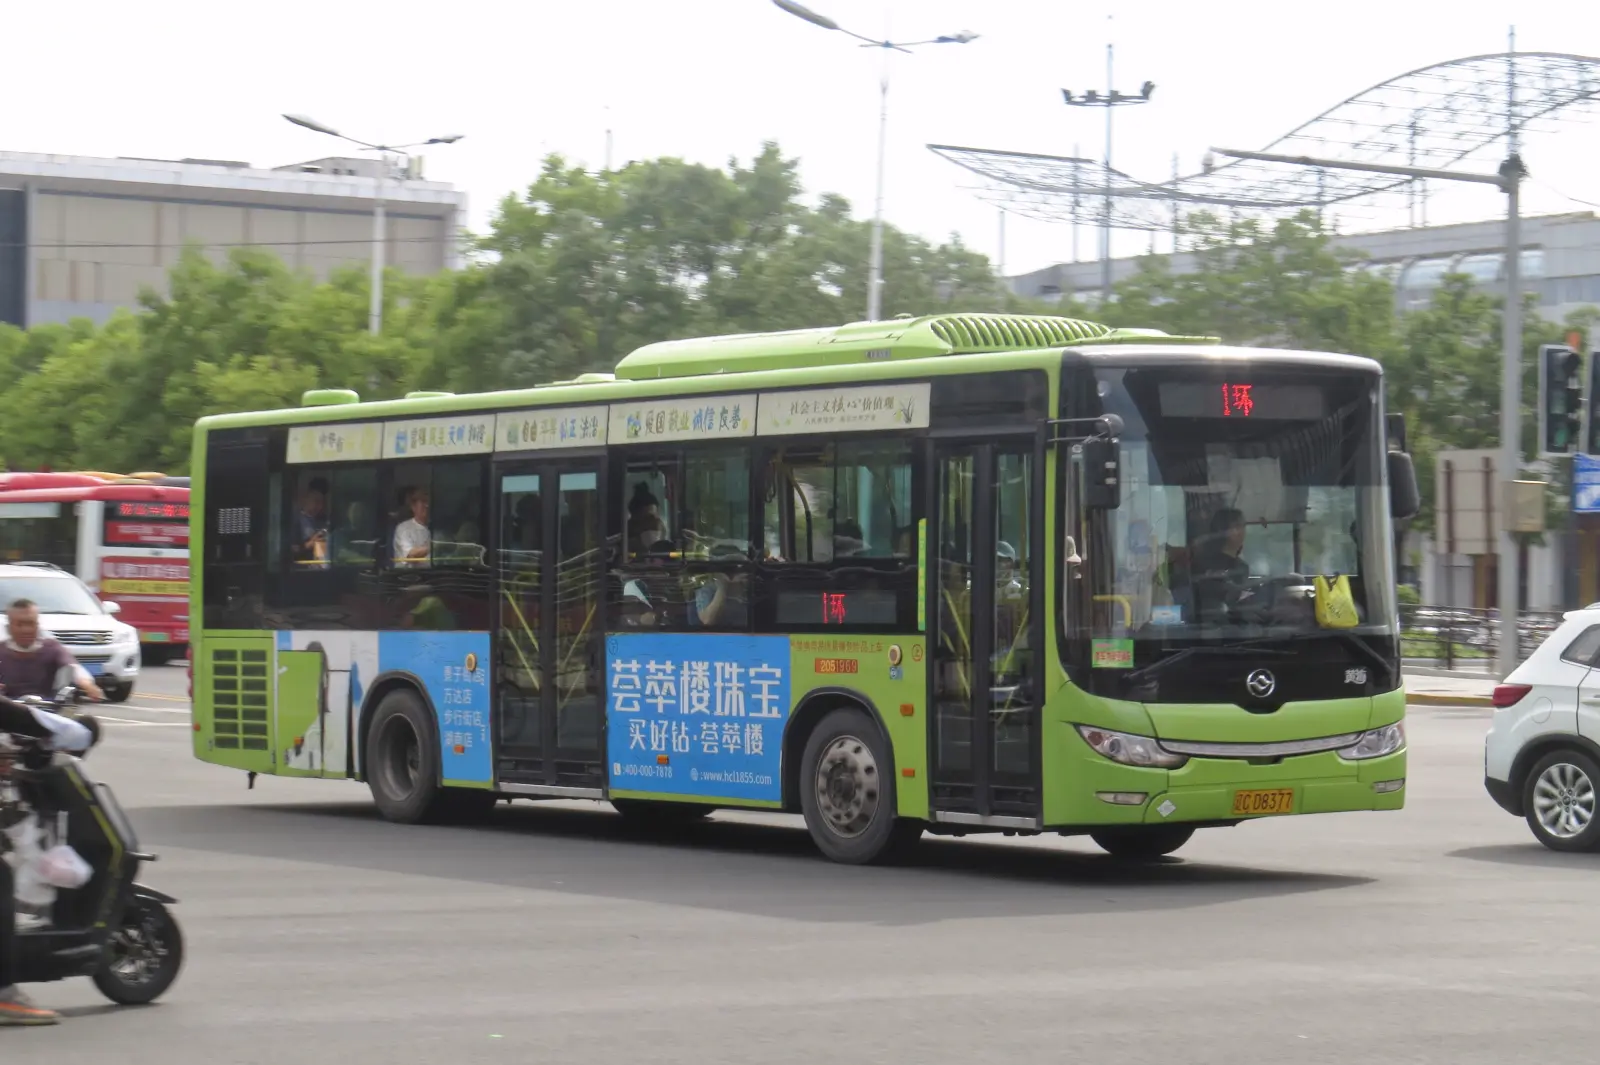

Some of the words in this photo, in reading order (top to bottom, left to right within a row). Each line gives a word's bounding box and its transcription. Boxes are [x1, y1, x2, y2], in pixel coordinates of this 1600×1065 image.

[1222, 383, 1253, 416] 1环
[823, 592, 846, 624] 1环
[611, 659, 782, 719] 荟萃楼珠宝
[629, 718, 764, 756] 买好钻·荟萃楼
